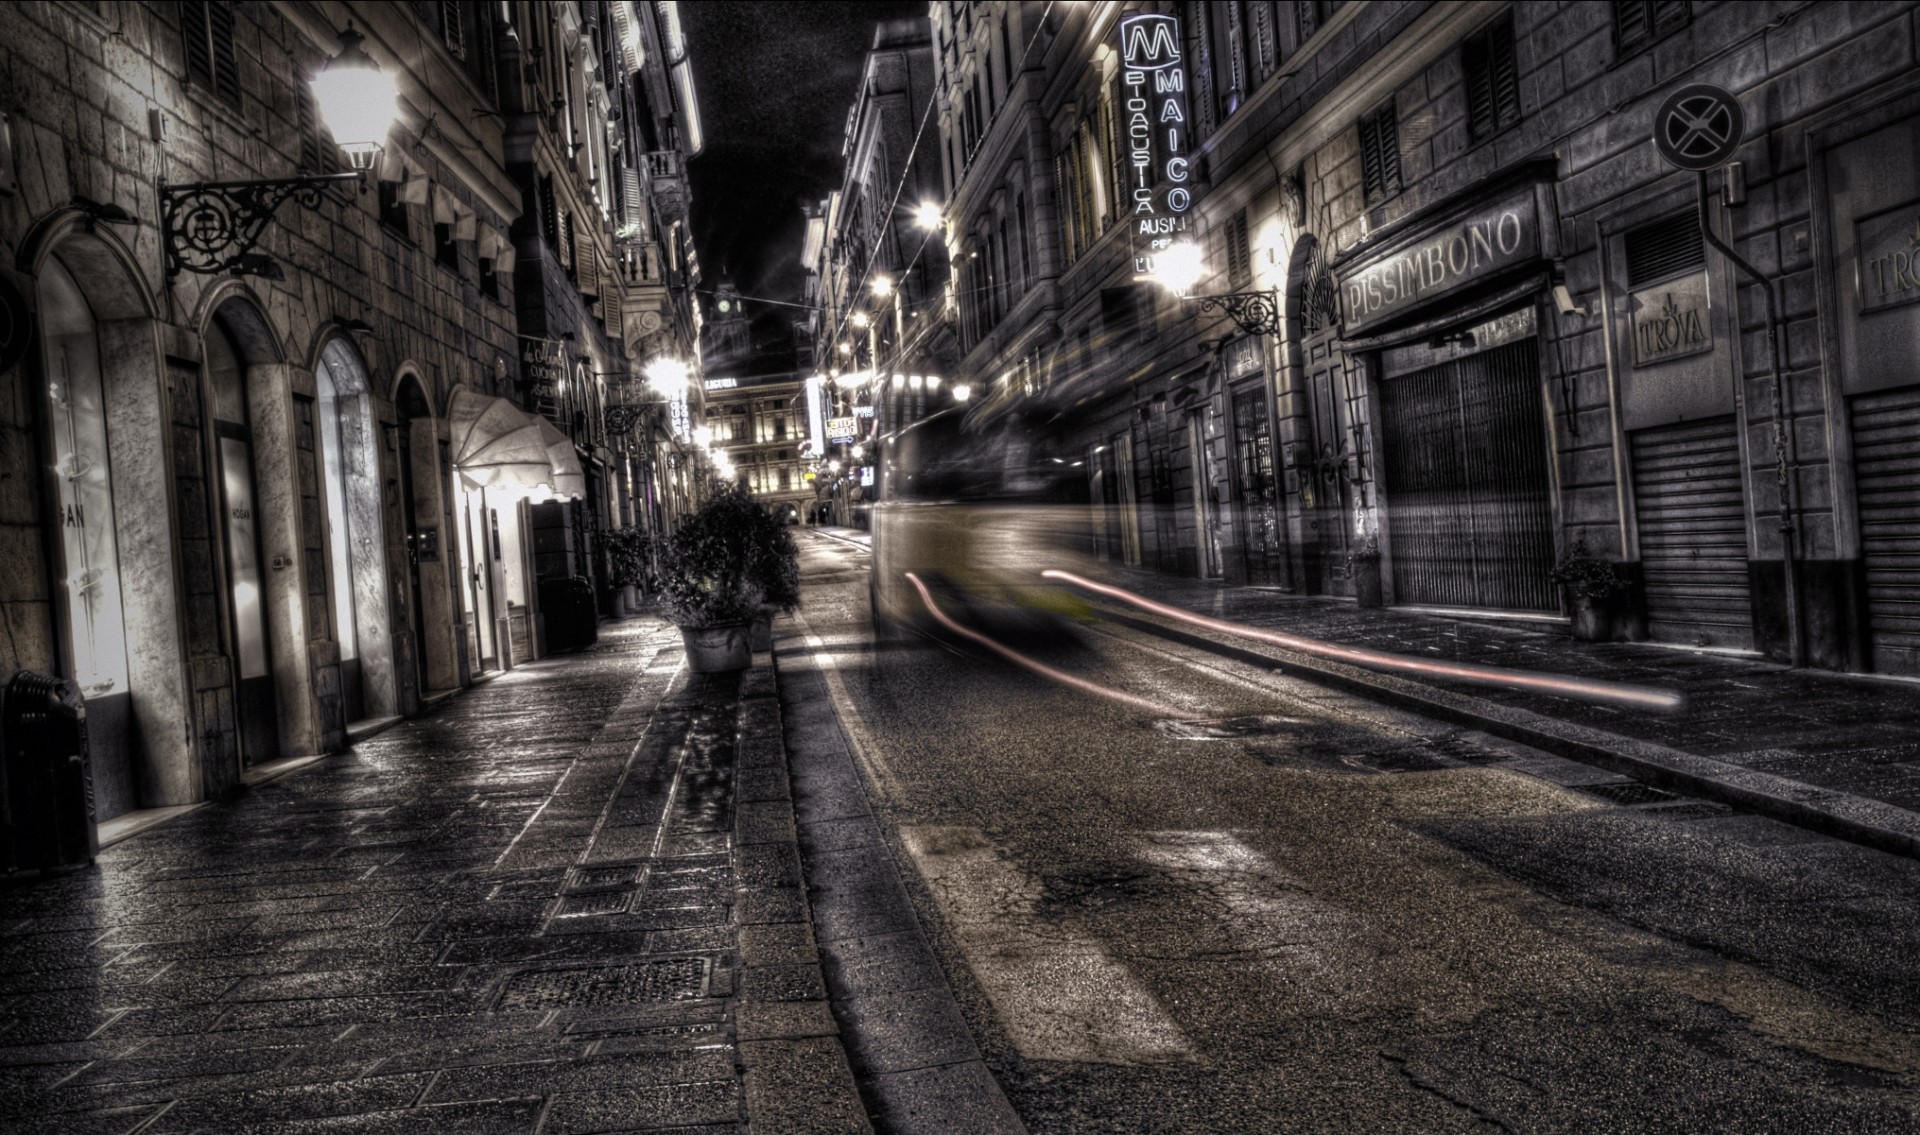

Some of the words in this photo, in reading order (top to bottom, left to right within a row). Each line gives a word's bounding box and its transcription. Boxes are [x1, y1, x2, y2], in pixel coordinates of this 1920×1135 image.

[1125, 71, 1154, 214] BIOACUSTICA
[1155, 69, 1190, 212] MAICO
[1349, 212, 1522, 321] PISSIMBONO
[1639, 308, 1705, 355] TROVA
[232, 508, 251, 520] HOGAN
